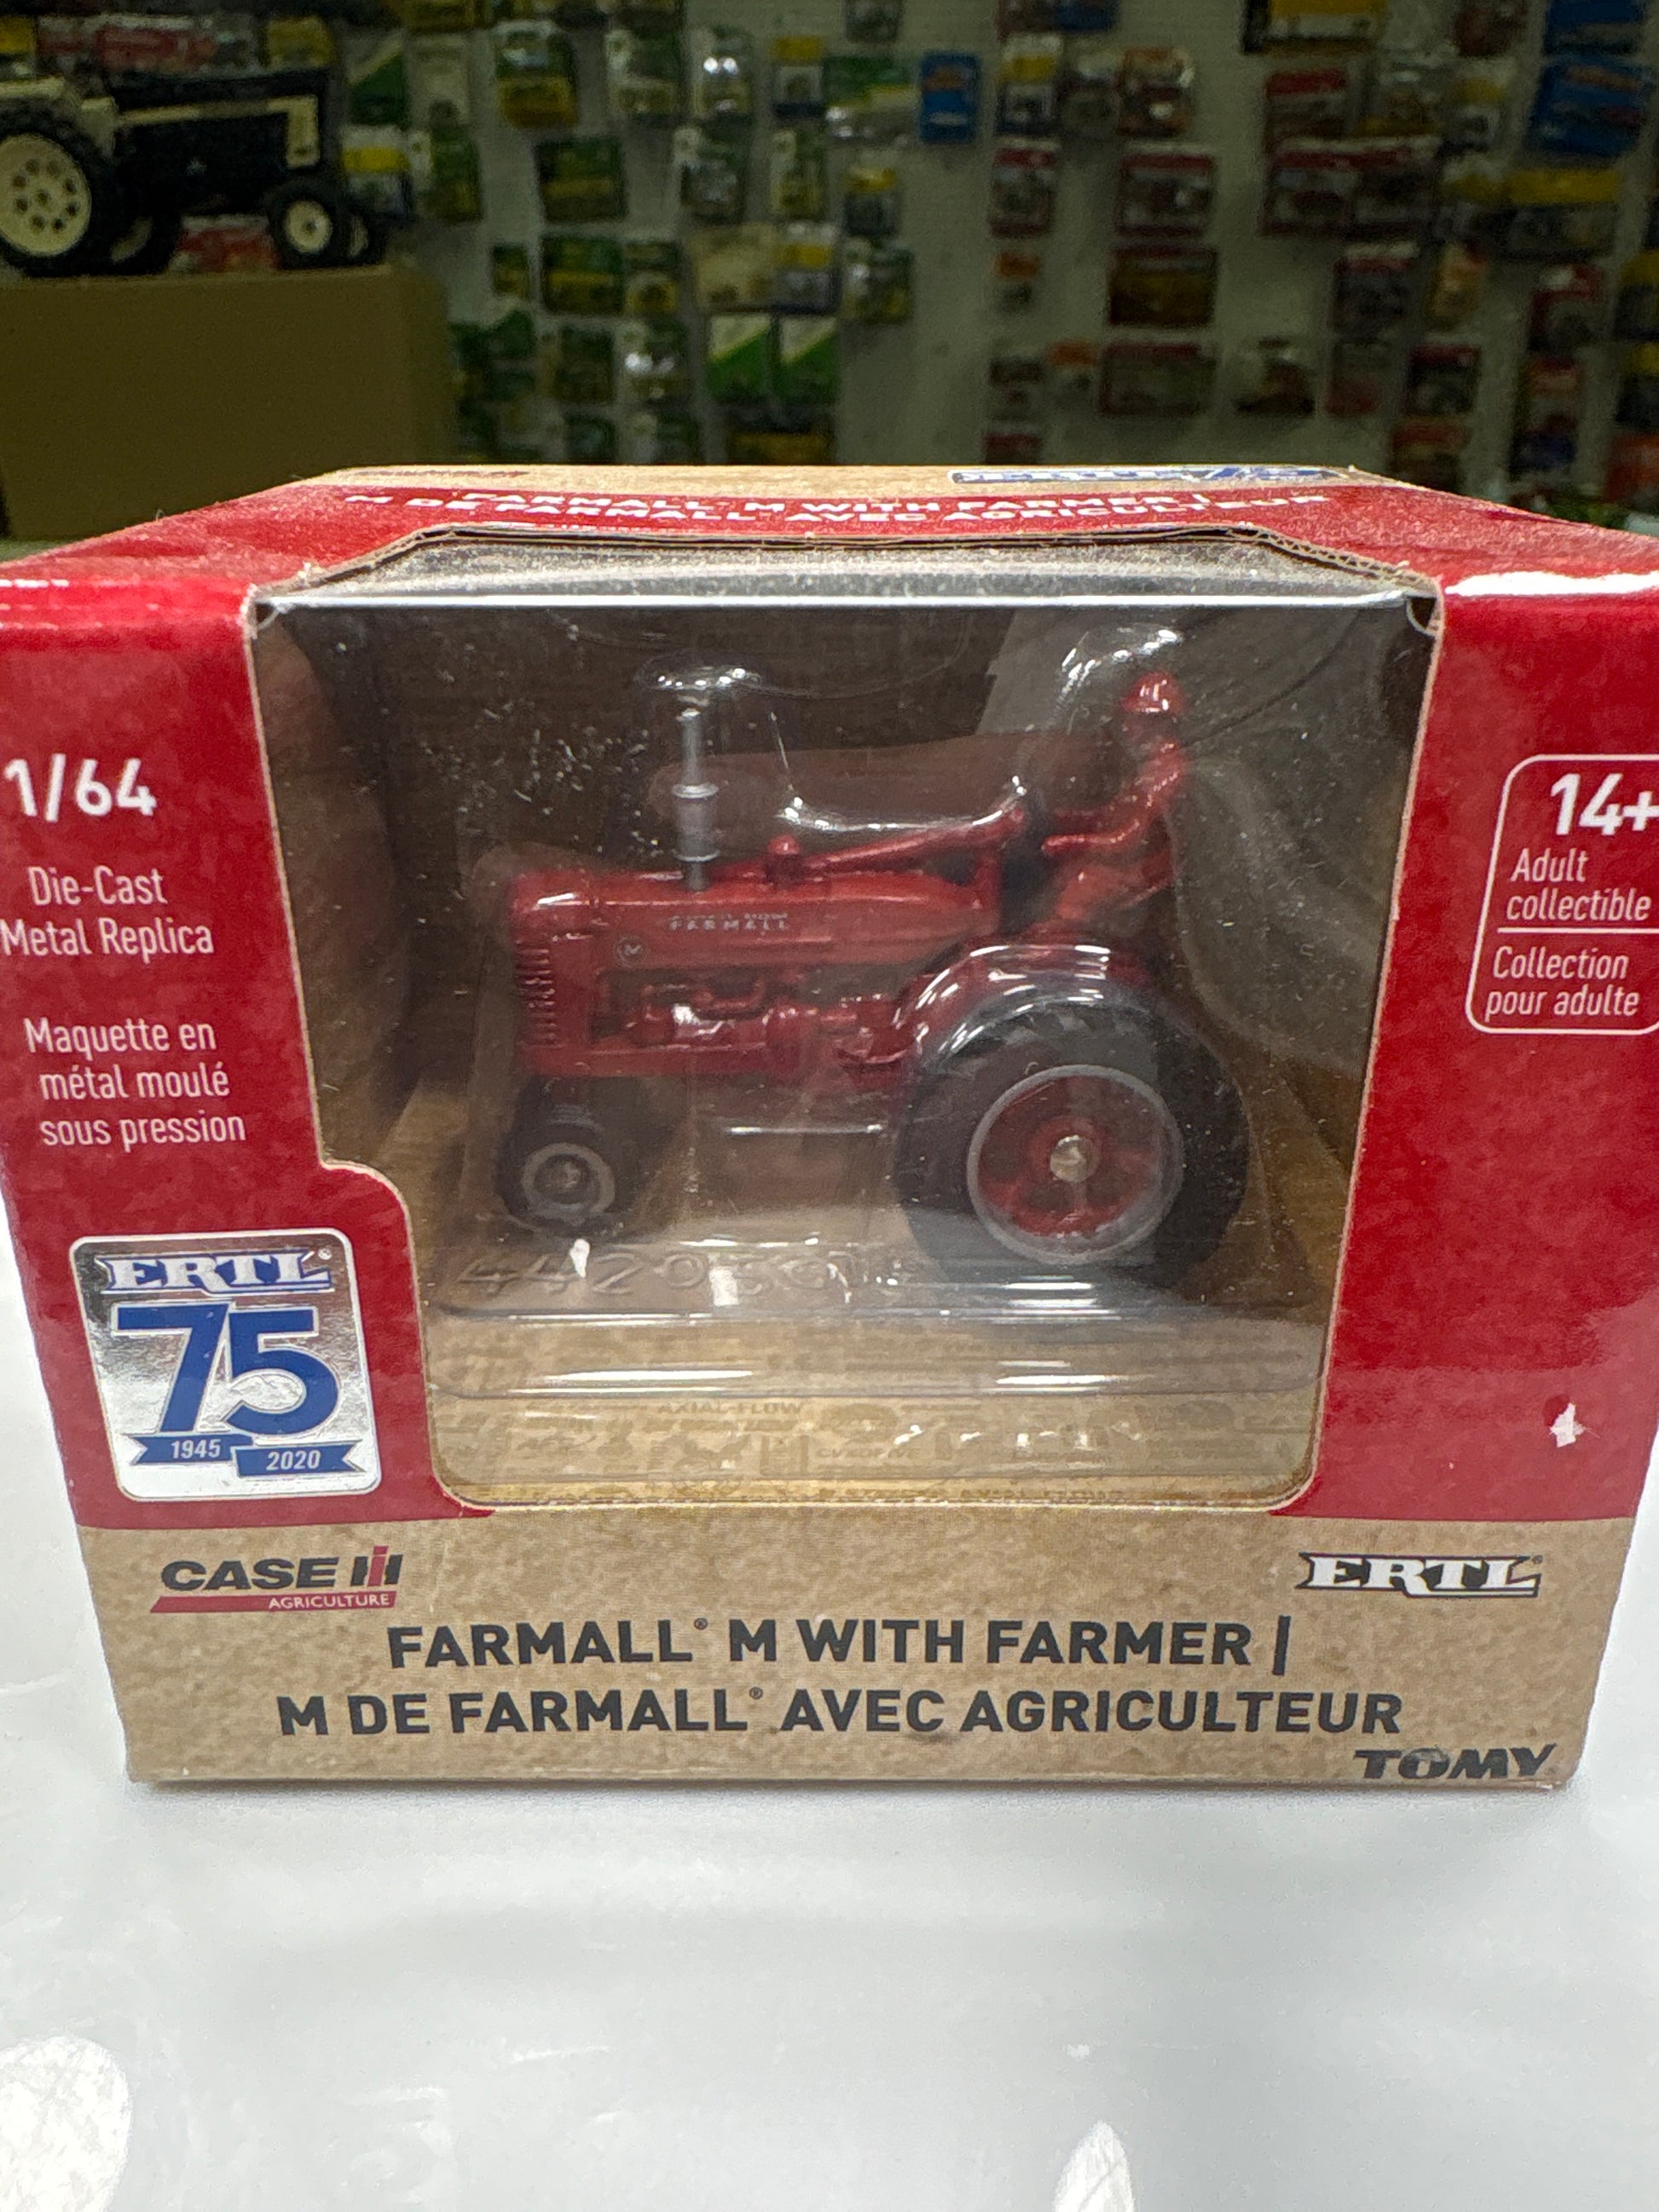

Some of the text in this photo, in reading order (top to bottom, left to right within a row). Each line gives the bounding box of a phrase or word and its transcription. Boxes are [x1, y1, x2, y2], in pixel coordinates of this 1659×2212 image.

[785, 511, 927, 522] AVEC
[802, 501, 939, 513] WITH
[958, 496, 1188, 511] FARMER
[5, 754, 158, 822] 1/64
[1550, 772, 1659, 835] 14+
[1510, 847, 1589, 883] Adult
[27, 865, 168, 905] Die-Cast
[1506, 887, 1652, 921] collectible
[0, 917, 214, 963] Metal Replica
[1493, 945, 1629, 980] Collection
[1484, 984, 1640, 1022] pour adulte
[23, 1018, 217, 1060] Maquette en
[40, 1061, 230, 1100] métal moulé
[40, 1110, 246, 1152] sous pression
[95, 1250, 335, 1297] ERTL
[116, 1302, 339, 1435] 75
[171, 1439, 221, 1459] 1945
[266, 1450, 321, 1471] 2020
[160, 1556, 339, 1591] CASE
[1297, 1551, 1541, 1598] ERTL
[269, 1591, 392, 1611] AGRICULTURE
[729, 1620, 777, 1662] M
[798, 1619, 964, 1665] WITH
[986, 1620, 1251, 1666] FARMER
[277, 1695, 329, 1736] M
[347, 1692, 431, 1736] DE
[781, 1689, 945, 1733] AVEC
[960, 1689, 1403, 1736] AGRICULTEUR
[1354, 1742, 1558, 1780] TOMY
